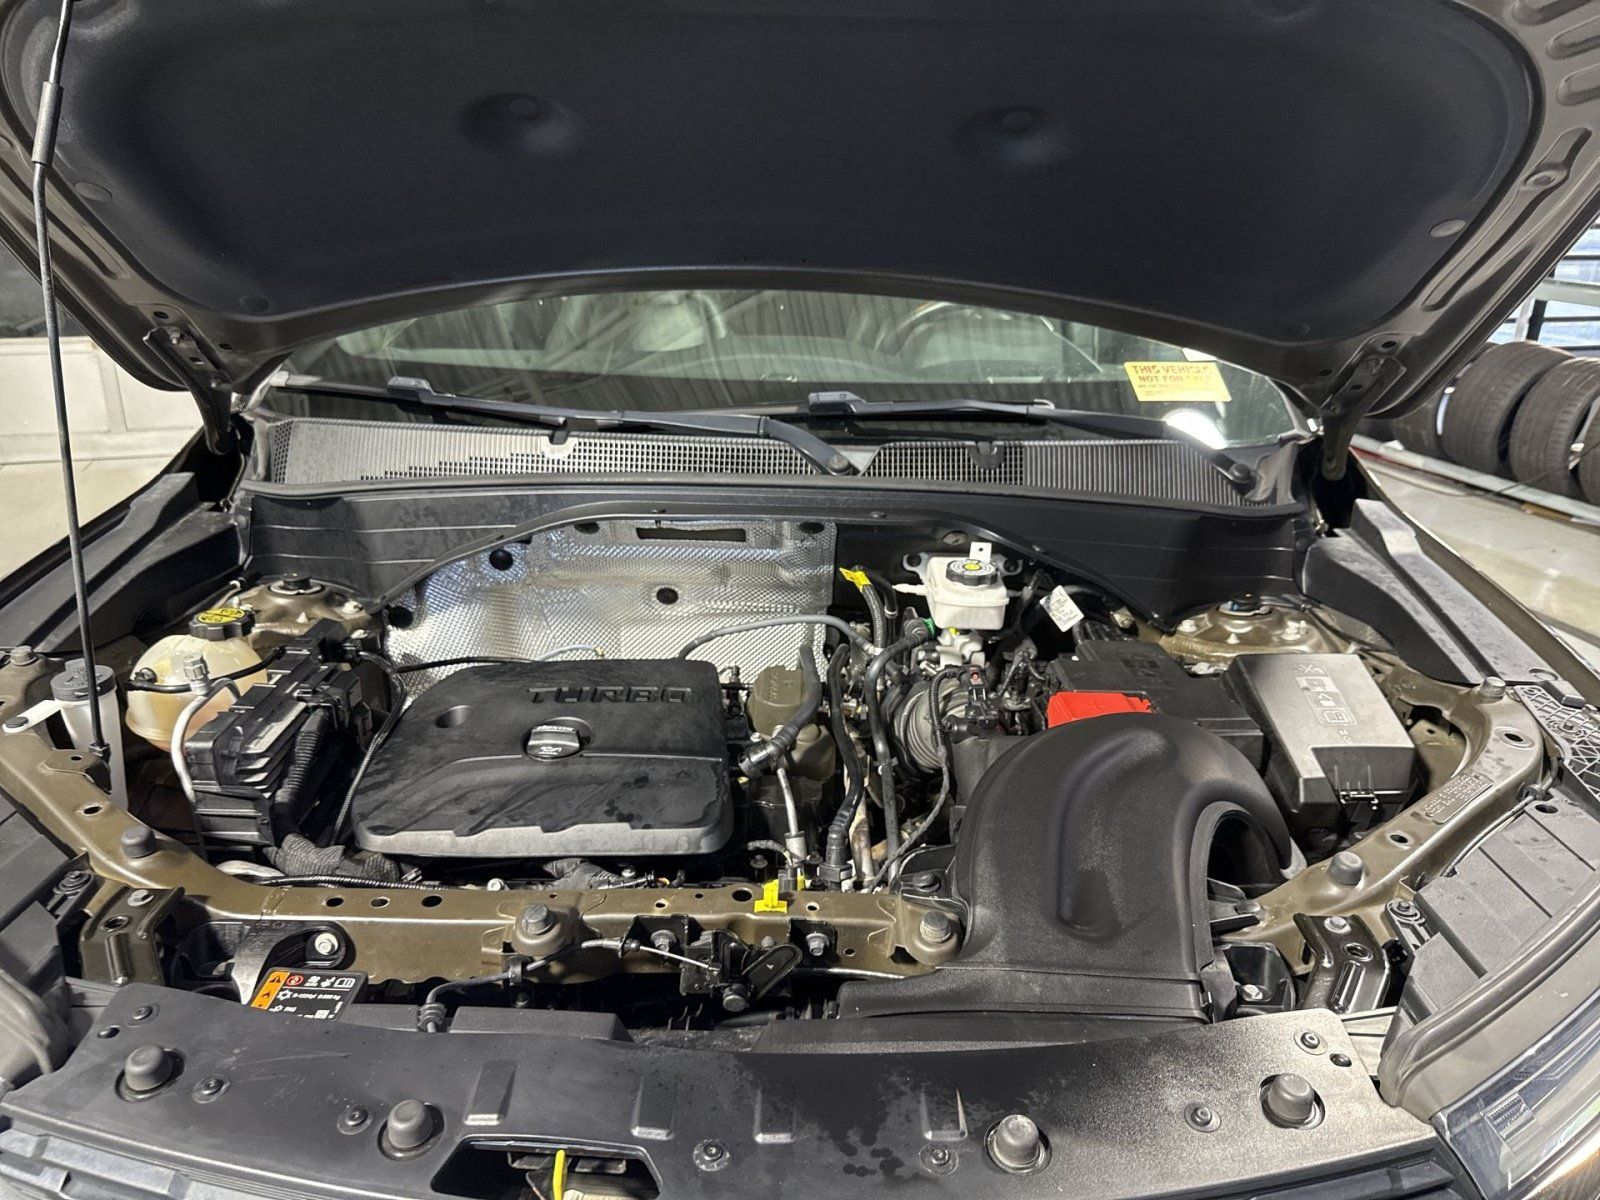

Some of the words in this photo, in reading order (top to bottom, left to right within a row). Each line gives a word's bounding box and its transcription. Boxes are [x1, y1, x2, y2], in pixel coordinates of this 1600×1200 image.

[1131, 365, 1160, 375] THIS
[1138, 375, 1159, 383] NOT
[528, 687, 692, 703] TURBO
